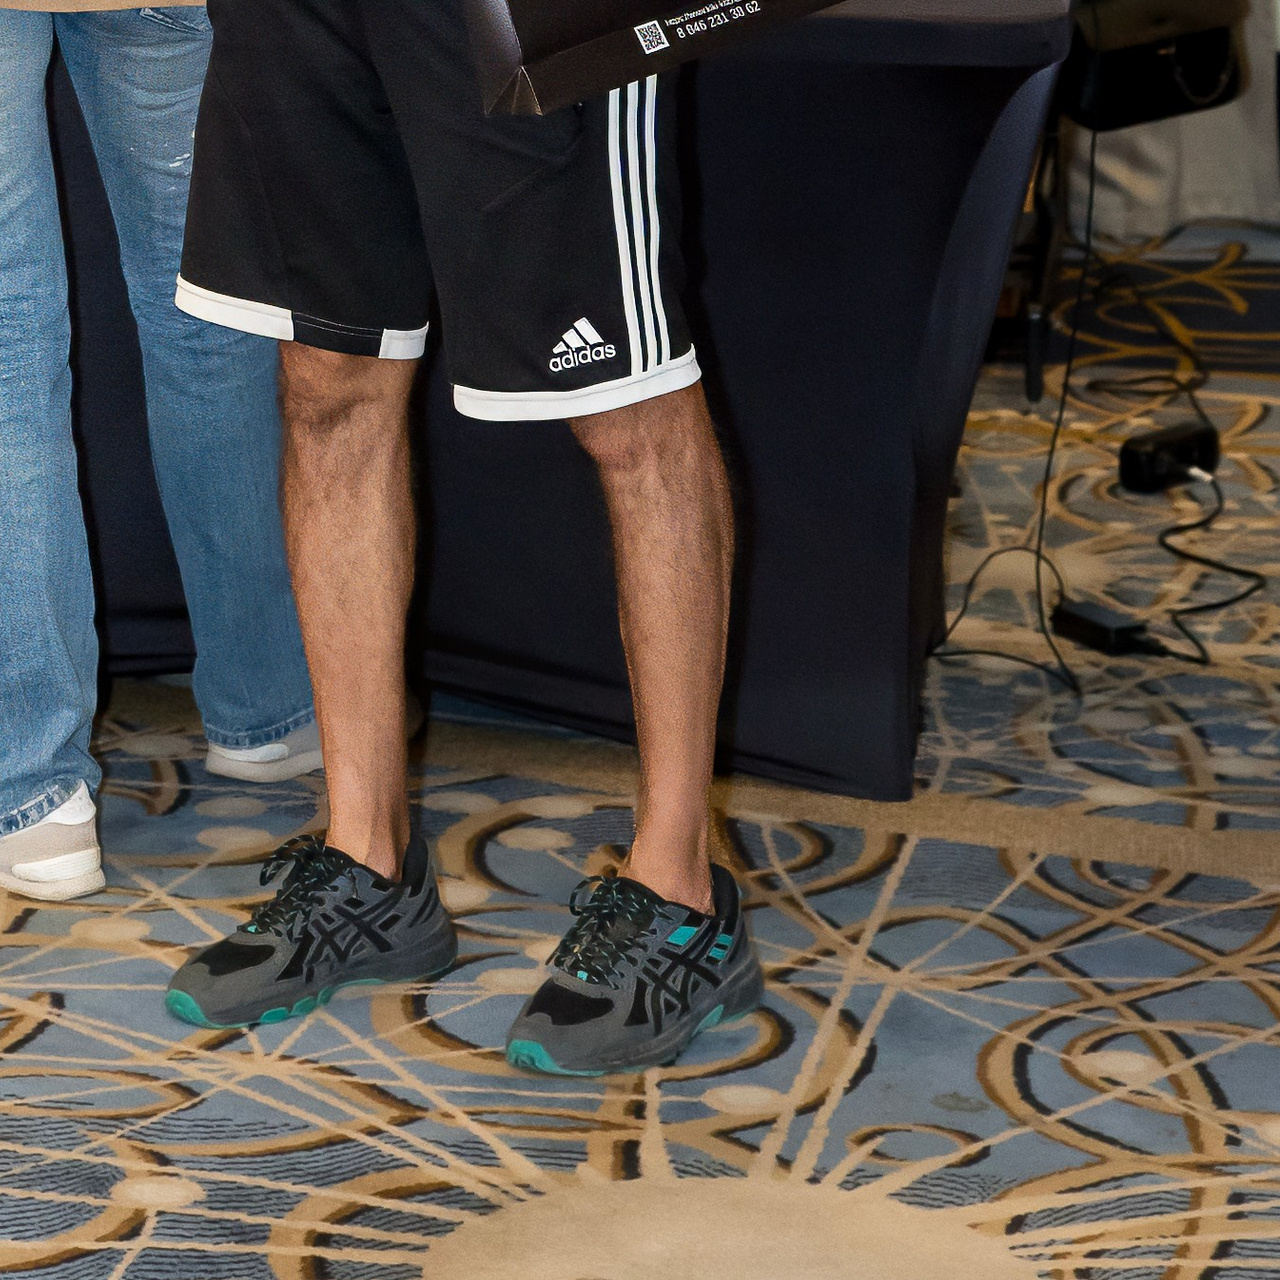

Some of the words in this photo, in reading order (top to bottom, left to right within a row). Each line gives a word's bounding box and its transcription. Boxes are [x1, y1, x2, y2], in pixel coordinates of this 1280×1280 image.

[676, 27, 687, 39] 8
[707, 12, 730, 28] 231
[549, 342, 617, 373] adidas
